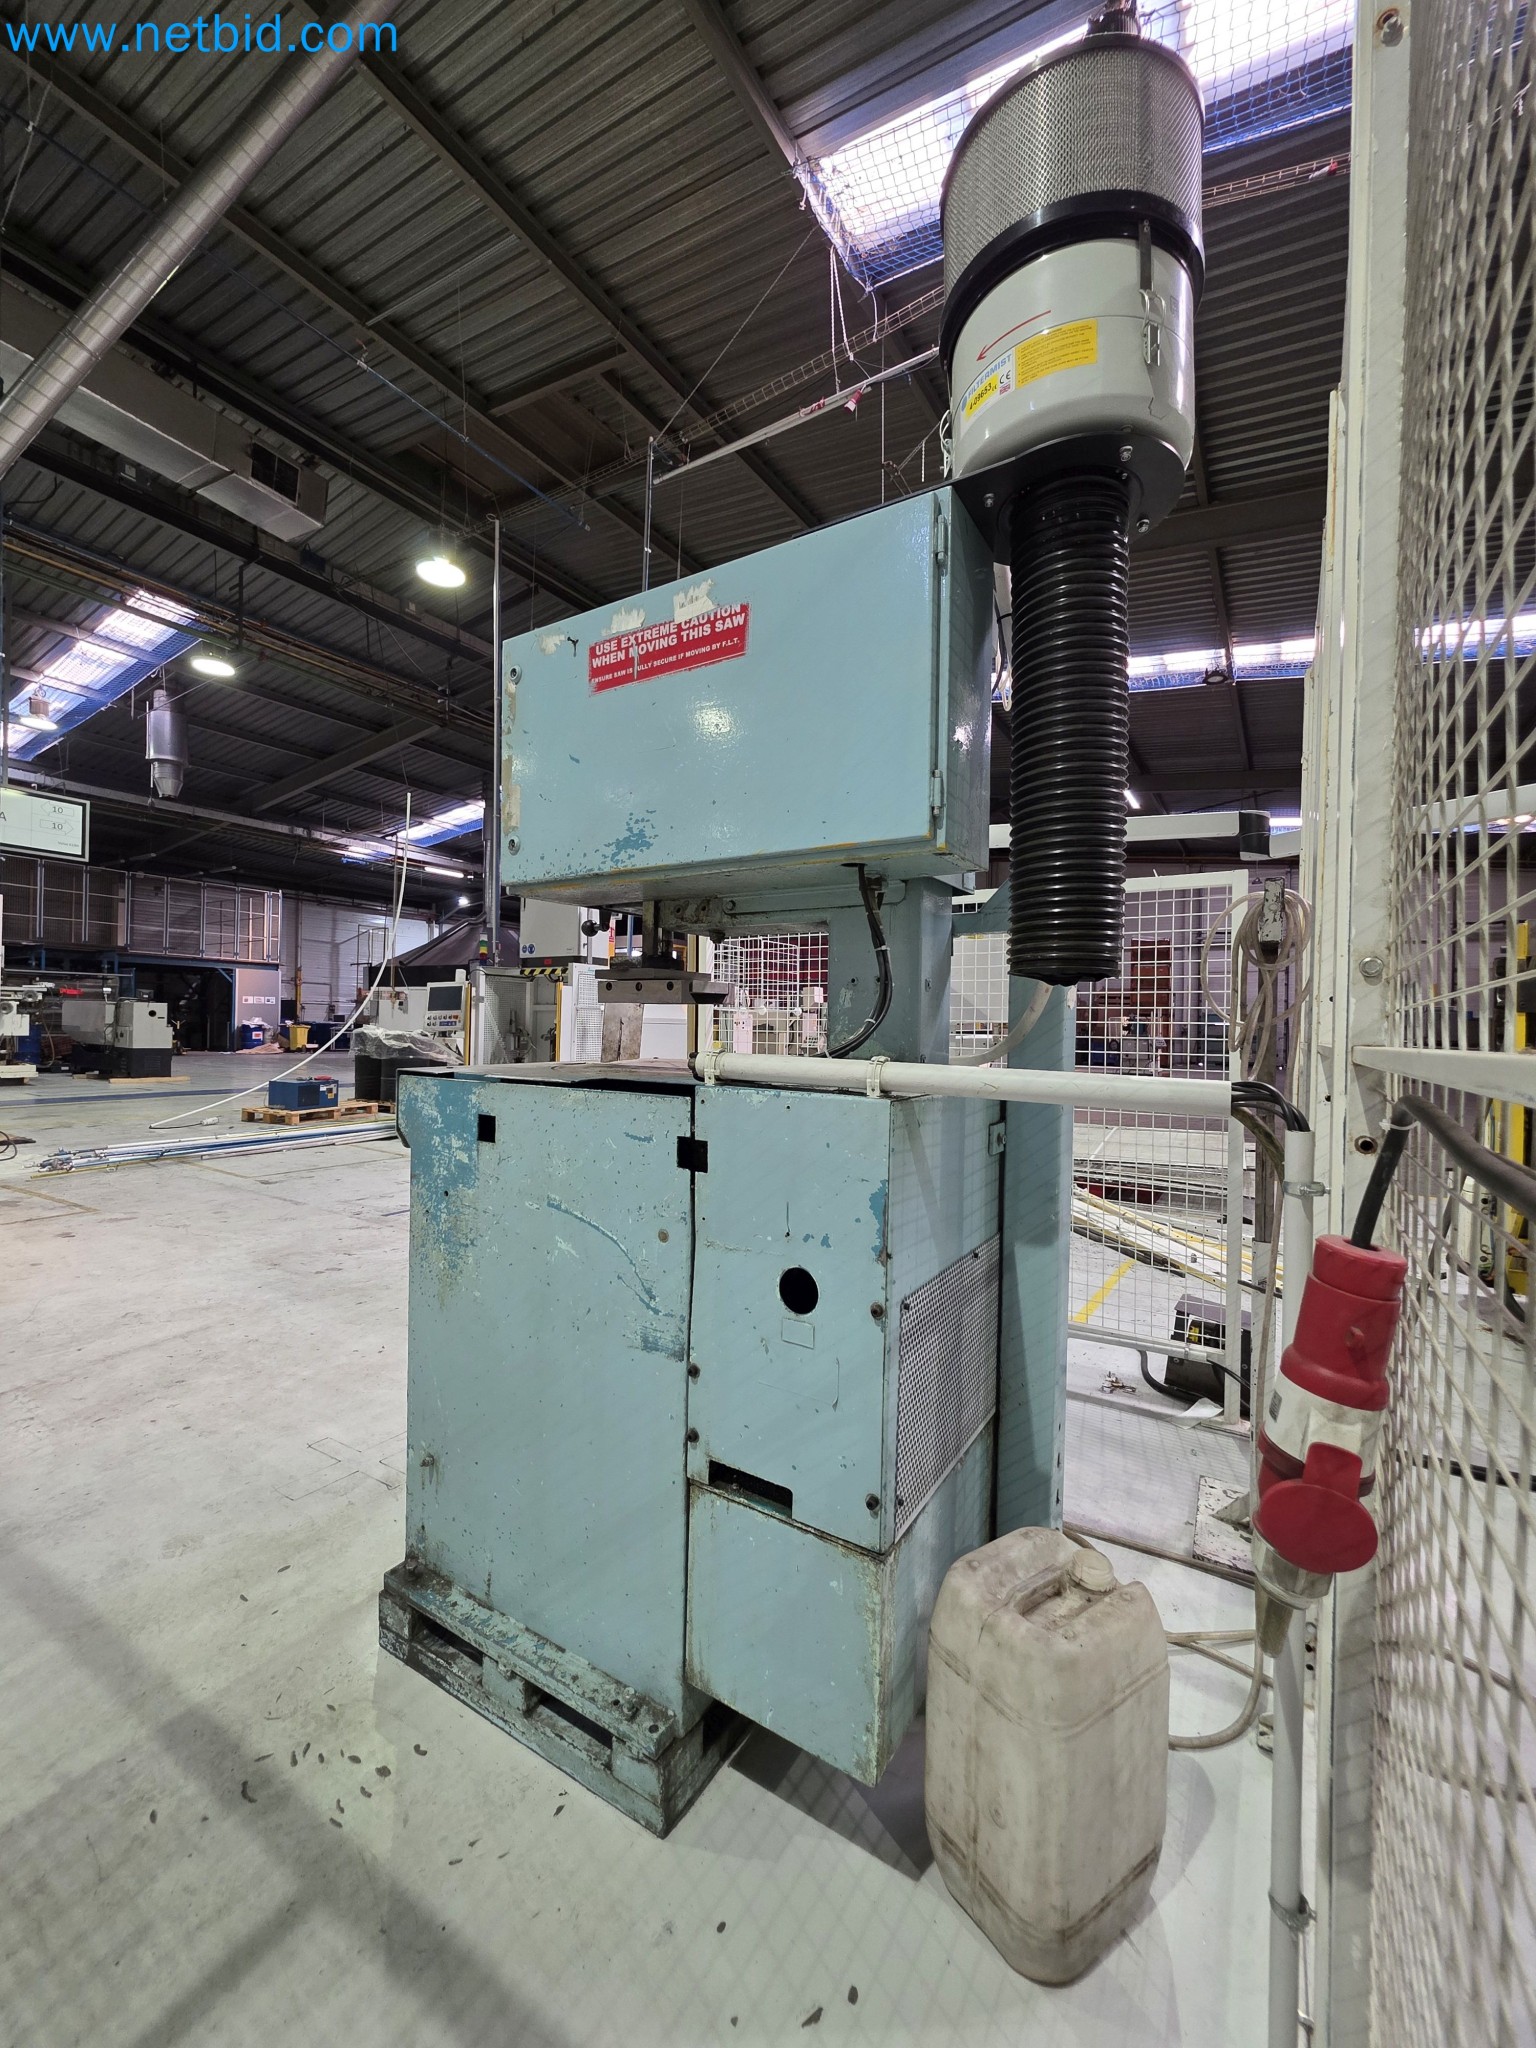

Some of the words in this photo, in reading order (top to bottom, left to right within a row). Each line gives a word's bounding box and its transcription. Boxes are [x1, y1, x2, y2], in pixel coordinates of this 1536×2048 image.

[968, 353, 1012, 399] FILTERMIST
[592, 650, 626, 669] WHEN
[681, 623, 712, 643] THIS
[715, 613, 746, 633] SAW
[595, 640, 618, 656] USE
[620, 622, 678, 649] EXTREME
[681, 604, 741, 630] CAUTION
[653, 655, 677, 668] SECURE
[685, 646, 711, 658] MOVING
[712, 642, 721, 650] BY
